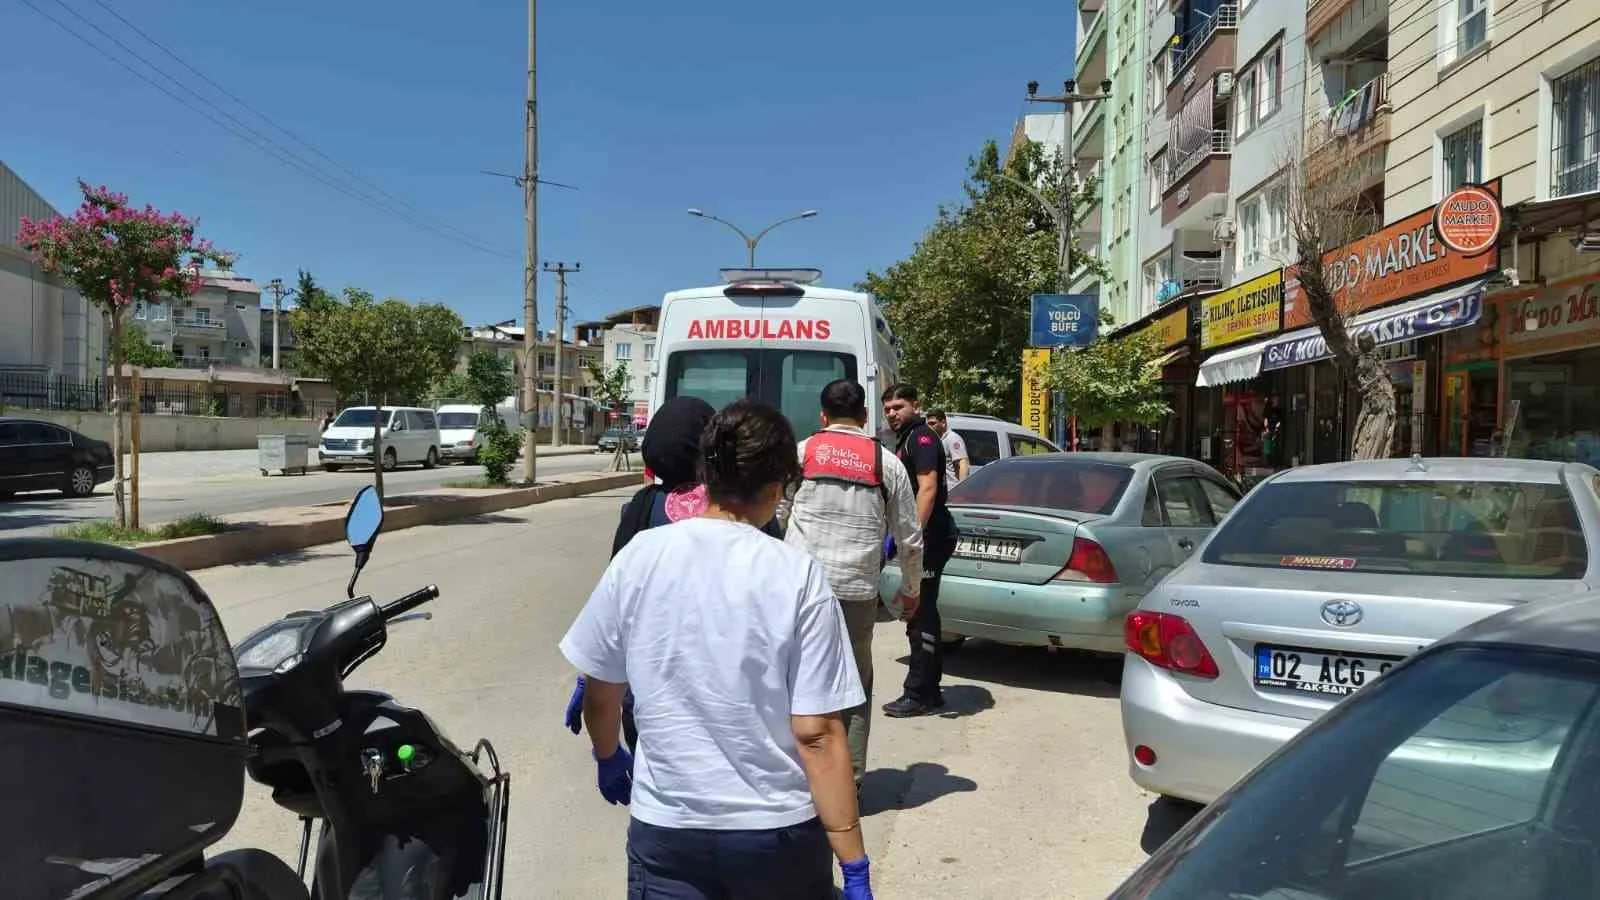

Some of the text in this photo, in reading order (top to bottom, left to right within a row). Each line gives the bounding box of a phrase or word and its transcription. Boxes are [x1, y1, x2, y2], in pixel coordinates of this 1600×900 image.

[1449, 200, 1489, 211] MUDO
[1444, 214, 1493, 225] MARKET
[1321, 254, 1361, 293] UDO
[1209, 283, 1280, 322] KILINÇ İLETİŞİM
[1048, 310, 1080, 321] YOLCU
[687, 319, 832, 339] AMBULANS
[1051, 320, 1079, 332] BÜFE
[970, 538, 990, 553] AEV
[996, 541, 1018, 556] 412
[1170, 599, 1201, 608] TOYOTA
[1260, 665, 1270, 673] TR
[1273, 652, 1302, 680] 02
[1319, 656, 1365, 687] ACG
